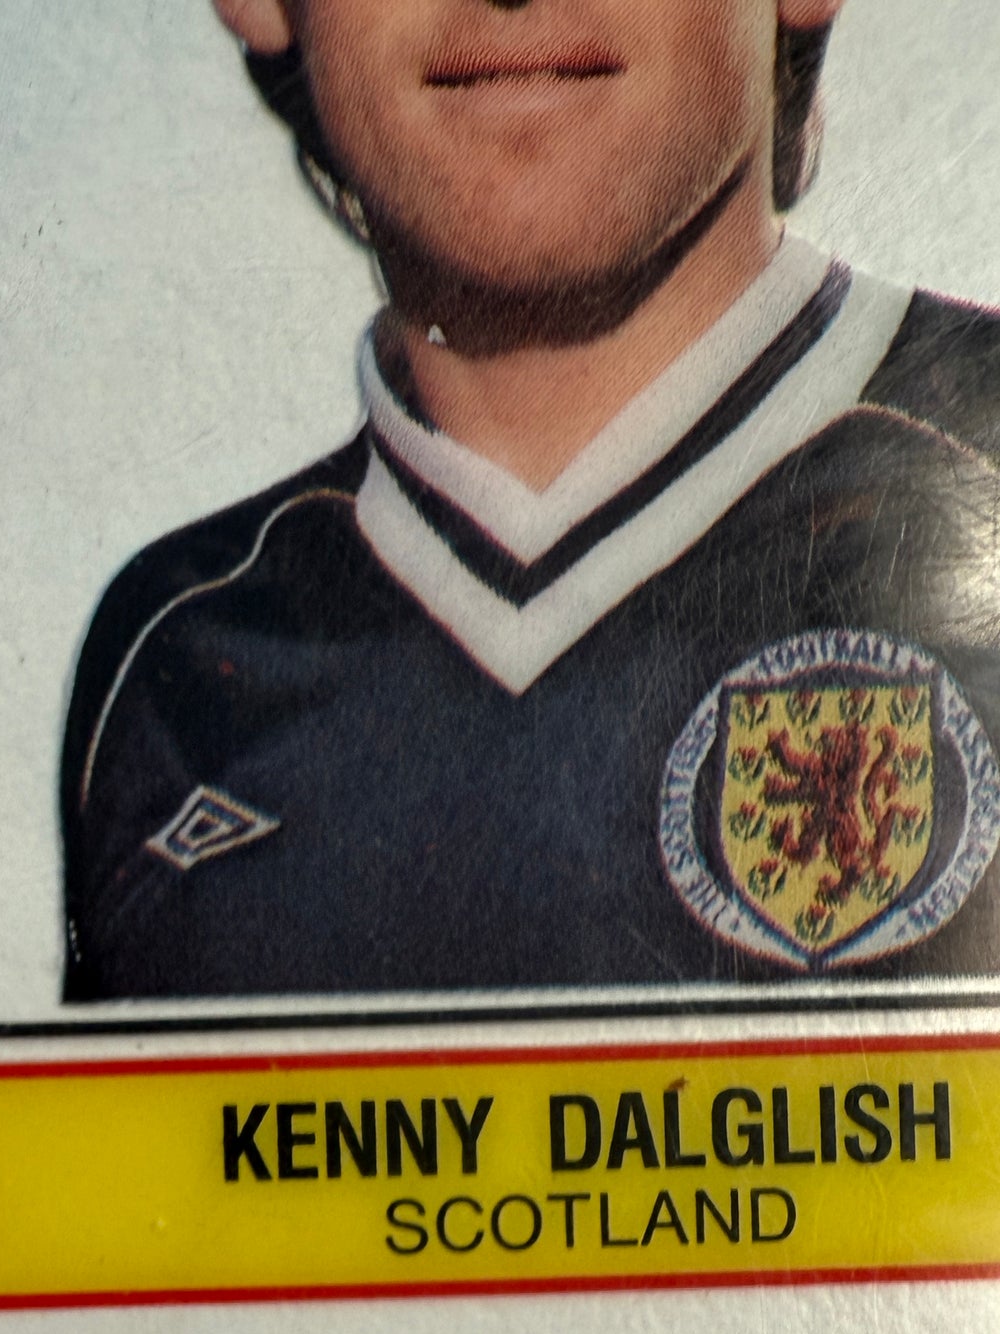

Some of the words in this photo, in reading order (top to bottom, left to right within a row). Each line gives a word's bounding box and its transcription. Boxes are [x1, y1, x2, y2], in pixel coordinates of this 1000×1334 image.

[757, 632, 899, 673] FOOTBALL
[222, 1095, 494, 1183] KENNY
[549, 1081, 952, 1173] DALGLISH
[384, 1186, 798, 1257] SCOTLAND
